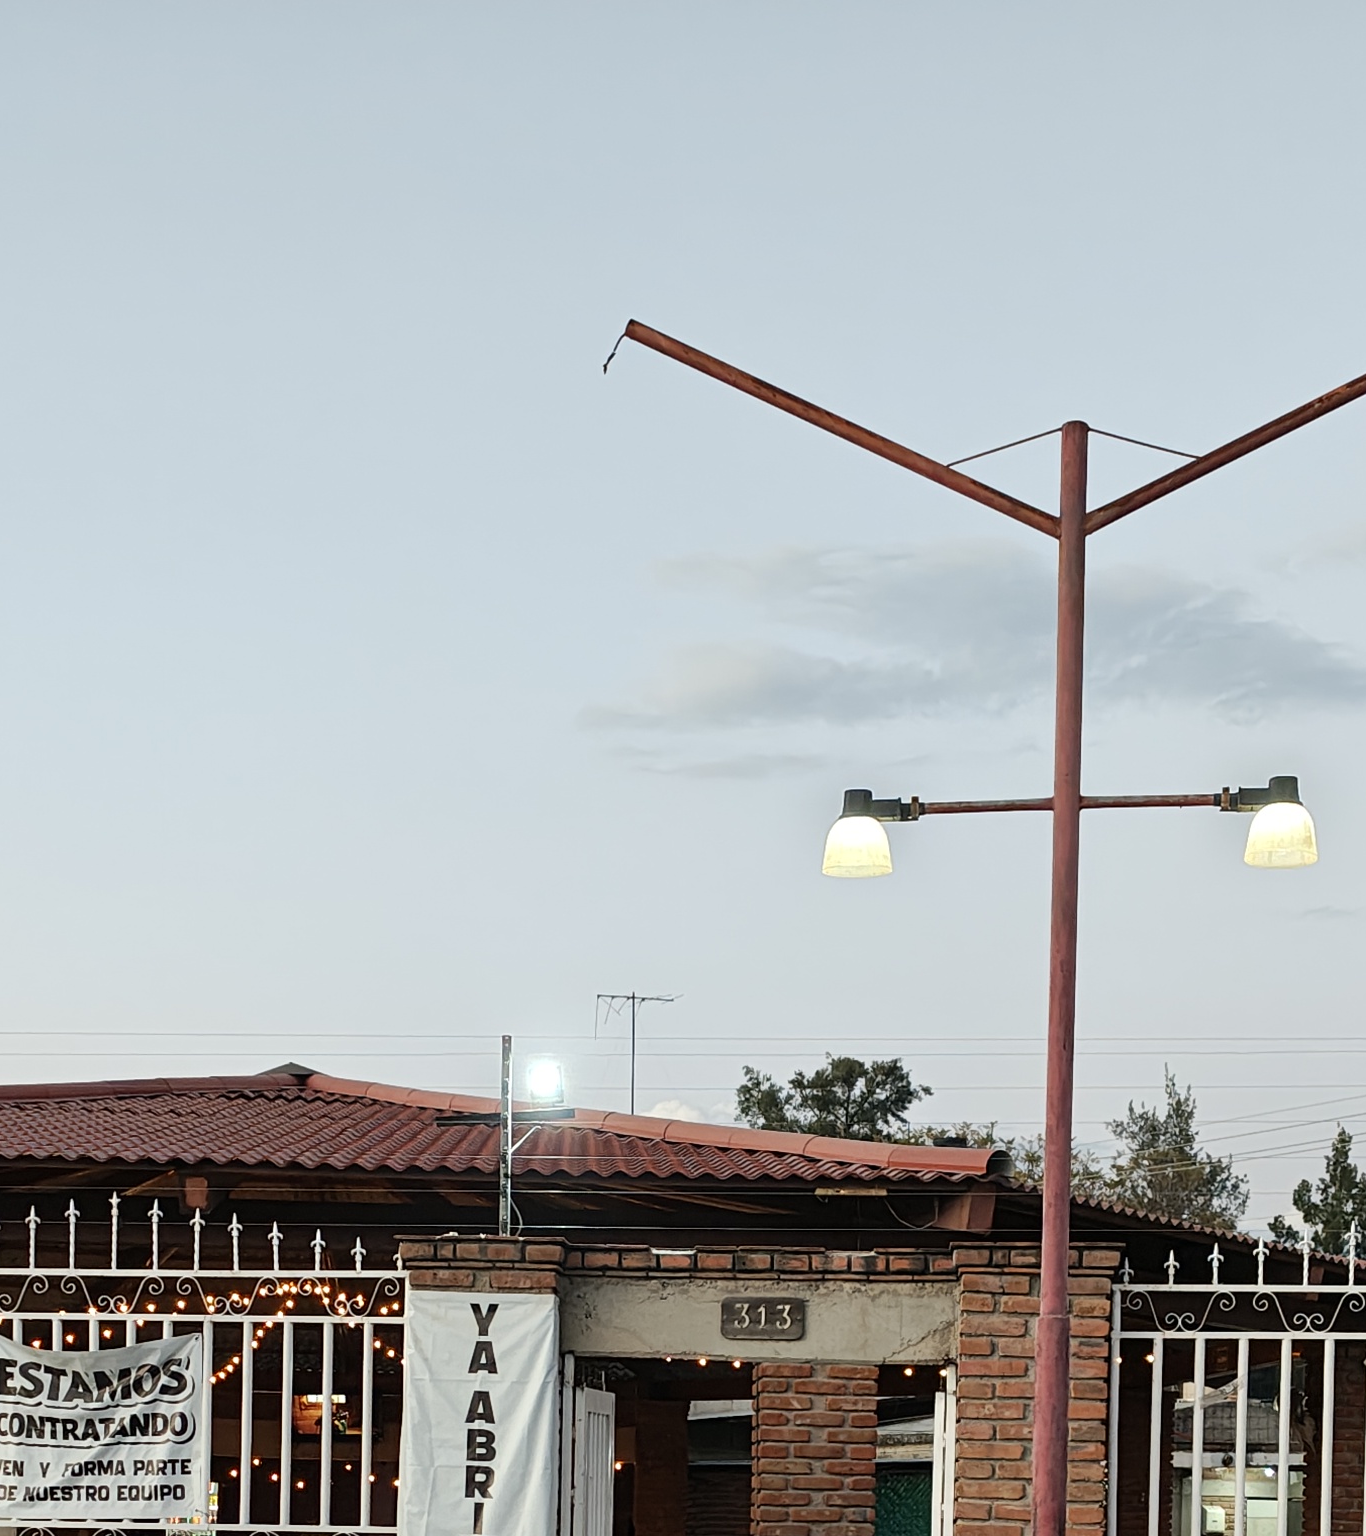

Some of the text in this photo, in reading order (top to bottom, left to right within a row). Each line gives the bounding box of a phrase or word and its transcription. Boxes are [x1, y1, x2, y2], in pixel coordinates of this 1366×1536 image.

[734, 1303, 792, 1330] 313
[468, 1303, 499, 1375] YA
[39, 1461, 51, 1479] Y
[62, 1459, 126, 1478] FORMA
[133, 1458, 192, 1476] PARTE
[22, 1485, 110, 1502] NUESTRO
[116, 1484, 186, 1502] EQUIPO
